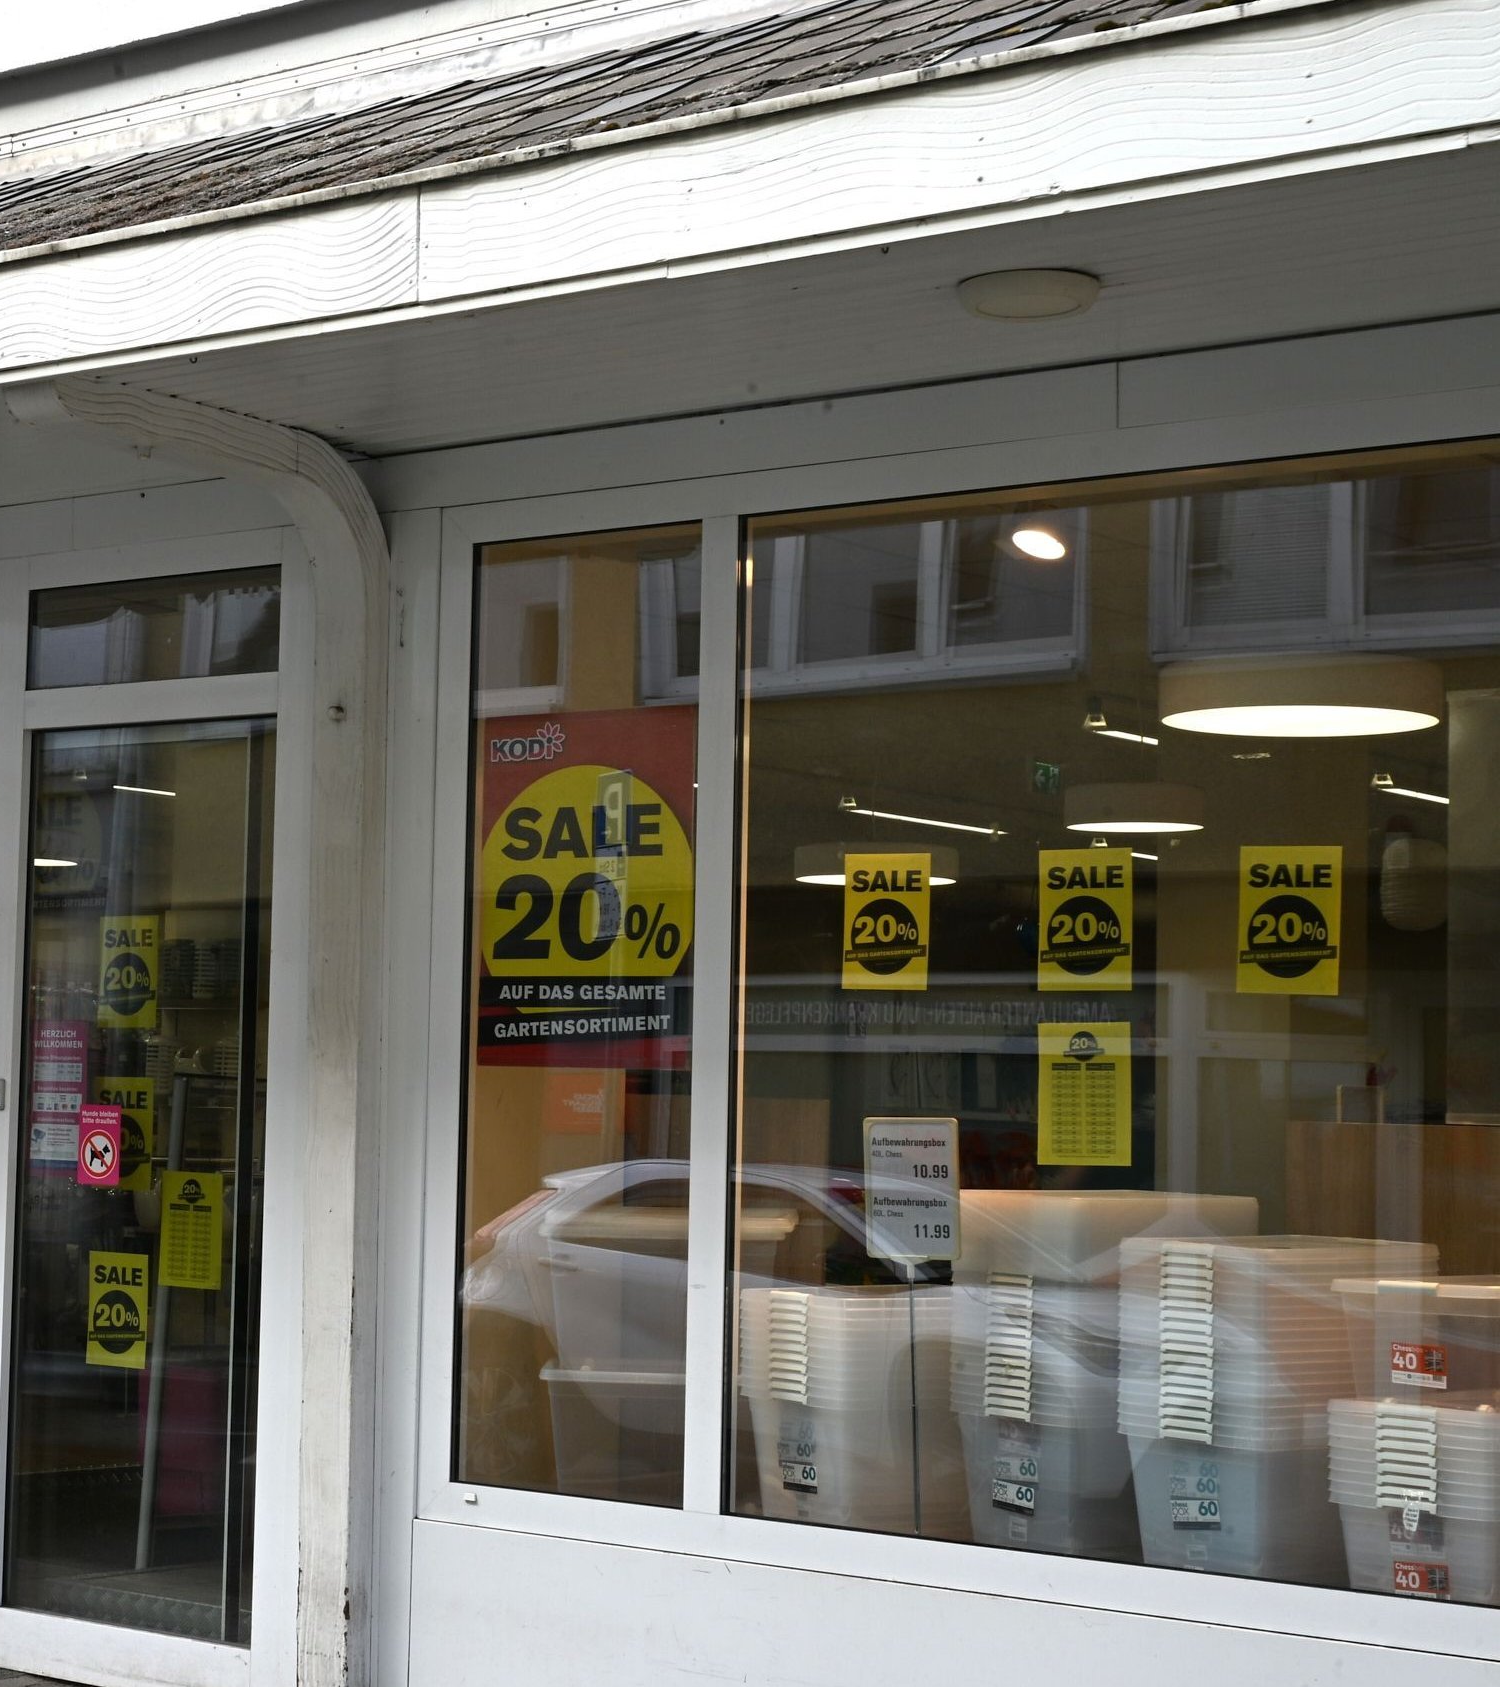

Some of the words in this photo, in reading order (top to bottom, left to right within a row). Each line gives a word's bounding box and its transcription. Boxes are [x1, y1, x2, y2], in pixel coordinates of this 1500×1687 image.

[501, 803, 663, 861] SALE
[852, 870, 922, 893] SALE
[1047, 865, 1124, 890] SALE
[1248, 863, 1332, 888] SALE
[492, 873, 680, 961] 20%
[854, 914, 917, 944] 20%
[1051, 912, 1120, 944] 20%
[1251, 912, 1326, 944] 20%
[105, 928, 153, 948] SALE
[106, 966, 149, 991] 20%
[499, 985, 534, 1001] AUF
[539, 985, 574, 1001] DAS
[579, 984, 666, 1001] GESAMTE
[41, 1029, 76, 1039] HERZLICH
[494, 1015, 671, 1038] GARTENSORTIMENT
[34, 1039, 83, 1049] WILLKOMMEN
[100, 1090, 148, 1109] SALE
[872, 1137, 946, 1148] Aufbewahrungsbox
[913, 1164, 949, 1179] 10.99
[873, 1197, 948, 1208] Aufbewahrungsbox
[914, 1224, 950, 1239] 11.99
[94, 1264, 142, 1287] SALE
[95, 1303, 139, 1328] 20%
[1393, 1352, 1417, 1370] 40
[796, 1443, 811, 1458] 60
[802, 1466, 816, 1481] 60
[1019, 1461, 1036, 1476] 60
[1016, 1487, 1033, 1502] 60
[1196, 1478, 1216, 1494] 60
[1198, 1501, 1218, 1516] 60
[1396, 1571, 1420, 1588] 40
